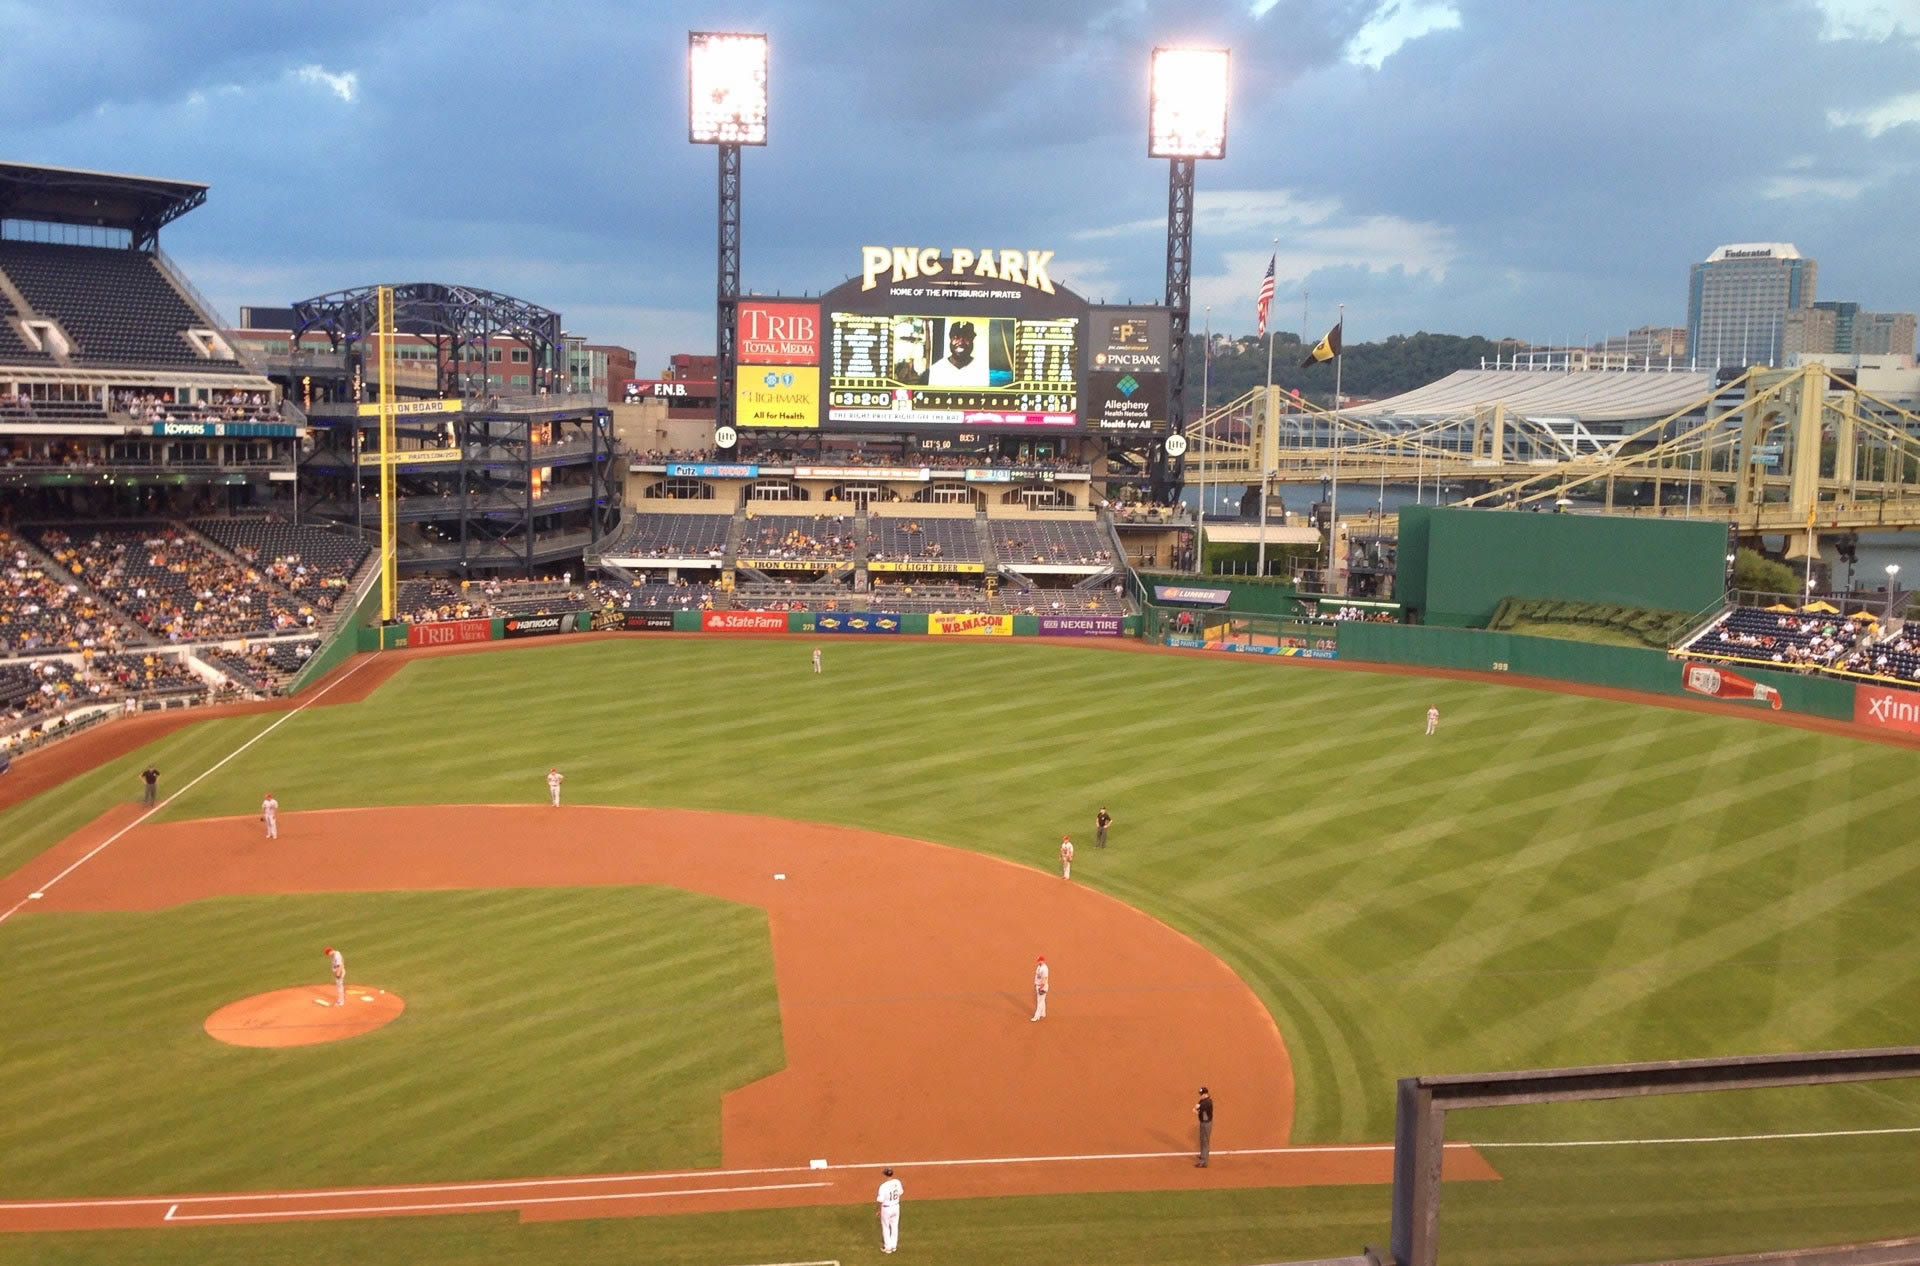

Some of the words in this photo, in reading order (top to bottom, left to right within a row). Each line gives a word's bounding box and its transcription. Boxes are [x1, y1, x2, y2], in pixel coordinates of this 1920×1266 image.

[1725, 248, 1771, 258] Federated
[862, 246, 944, 292] PNC
[952, 248, 1055, 295] PARK
[890, 288, 911, 296] HOME
[926, 289, 940, 297] THE
[941, 289, 988, 299] PITTSBURGH
[990, 290, 1021, 299] PIRATES
[742, 310, 814, 340] TRIB
[743, 342, 778, 353] TOTAL
[781, 342, 814, 354] MEDIA
[1108, 355, 1130, 364] PNC
[1132, 355, 1160, 365] BANK
[654, 384, 688, 396] F.N.B.
[748, 391, 810, 404] HIGHMARK
[843, 392, 853, 405] 3
[861, 392, 871, 405] 2
[398, 404, 410, 412] ON
[413, 402, 443, 411] BOARD
[1105, 400, 1149, 411] Allegheny
[779, 412, 805, 420] Health
[1100, 419, 1126, 428] Health
[1127, 420, 1139, 428] for
[1139, 420, 1151, 428] All
[164, 424, 205, 435] KOPPERS
[718, 432, 734, 442] Lite
[959, 434, 974, 442] BUCS
[922, 440, 940, 448] LET'S
[1168, 440, 1184, 450] Lite
[810, 562, 837, 570] BEER
[906, 563, 933, 571] LIGHT
[1179, 591, 1215, 599] LUMBER
[591, 612, 624, 627] PIRATES
[459, 623, 484, 633] TOTAL
[1060, 621, 1093, 629] NEXEN
[1096, 621, 1118, 629] TIRE
[414, 626, 455, 645] TRIB
[461, 631, 486, 640] MEDIA
[1180, 640, 1198, 648] PAINTS
[1313, 651, 1332, 659] PAINTS
[1868, 695, 1919, 723] xfini
